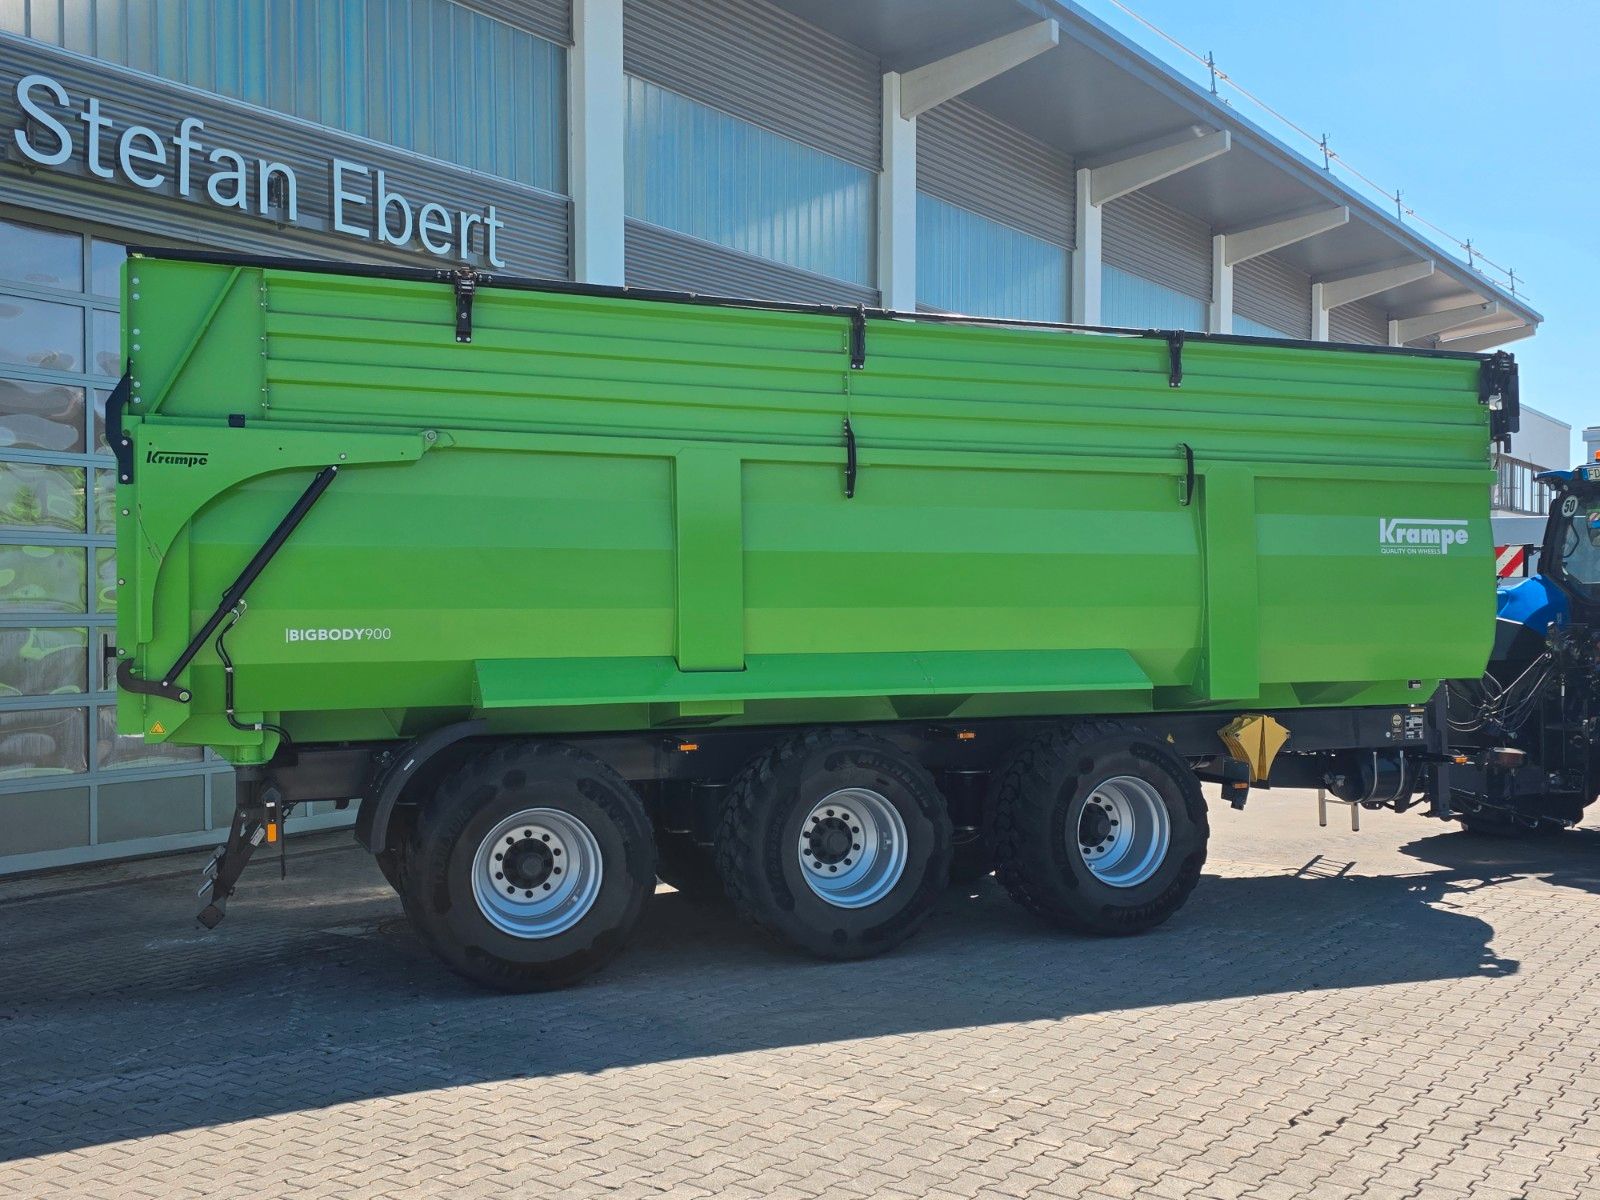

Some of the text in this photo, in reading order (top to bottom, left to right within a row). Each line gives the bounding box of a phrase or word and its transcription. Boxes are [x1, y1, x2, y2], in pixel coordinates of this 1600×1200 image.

[14, 74, 506, 269] Stefan Ebert
[146, 450, 209, 468] Krampe
[1564, 499, 1575, 513] 50
[1380, 518, 1469, 554] Krampe
